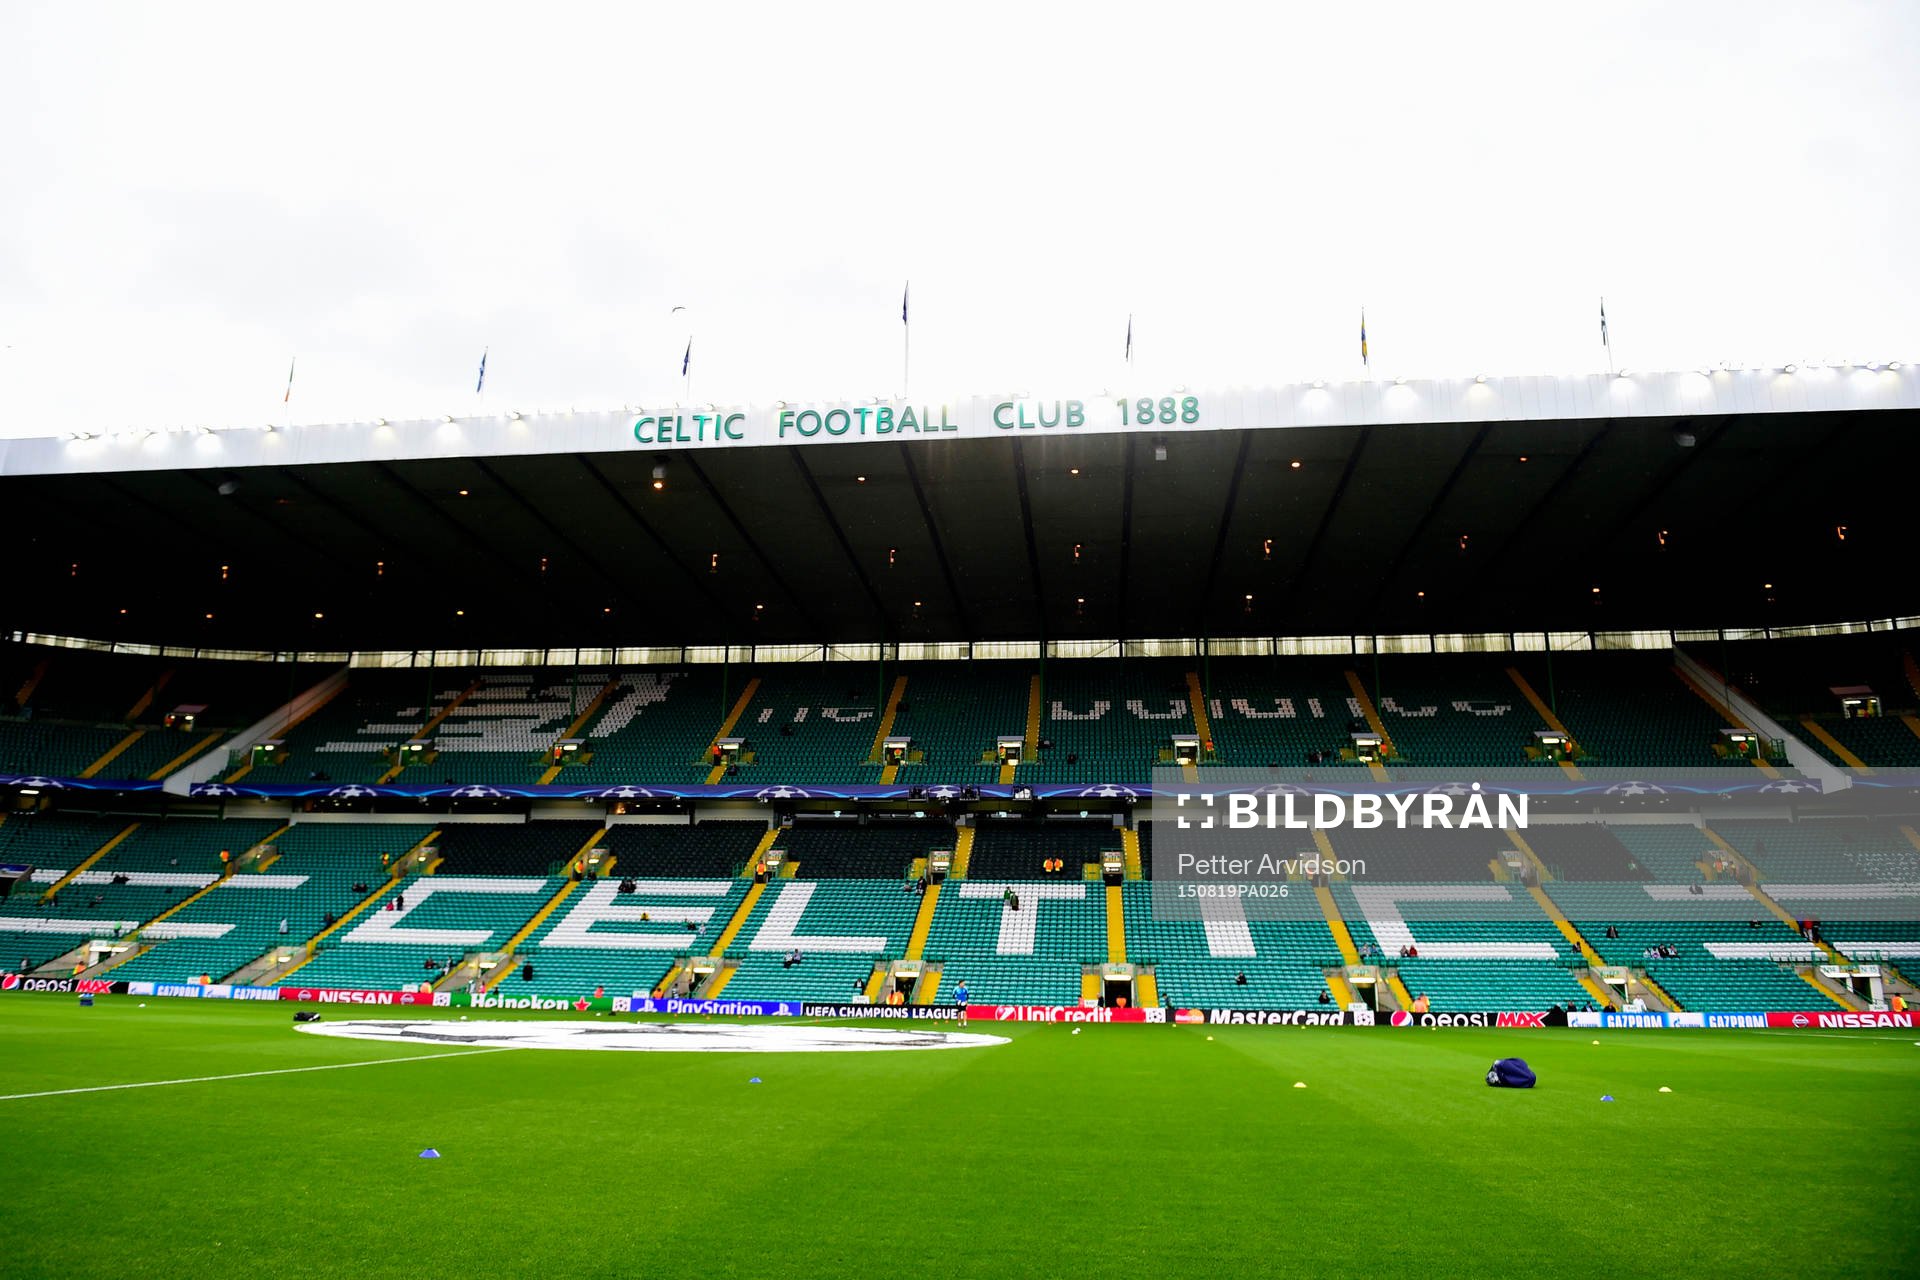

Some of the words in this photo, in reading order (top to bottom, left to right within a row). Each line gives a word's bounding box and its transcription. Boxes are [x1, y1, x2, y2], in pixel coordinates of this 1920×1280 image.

[634, 413, 745, 443] CELTIC
[779, 404, 958, 438] FOOTBALL
[993, 399, 1085, 429] CLUB
[1116, 396, 1200, 426] 1888
[23, 978, 72, 993] pepsi
[75, 979, 117, 994] MAX
[318, 990, 393, 1005] NISSAN
[470, 993, 570, 1011] Heineken
[667, 999, 763, 1015] PlayStation
[806, 1006, 836, 1017] UEFA
[839, 1006, 908, 1019] CHAMPIONS
[912, 1008, 957, 1019] LEAGUE
[1018, 1006, 1112, 1022] UniCredit
[1210, 1009, 1345, 1026] MasterCard
[1495, 1011, 1550, 1028] MAX
[1819, 1013, 1913, 1028] NISSAN
